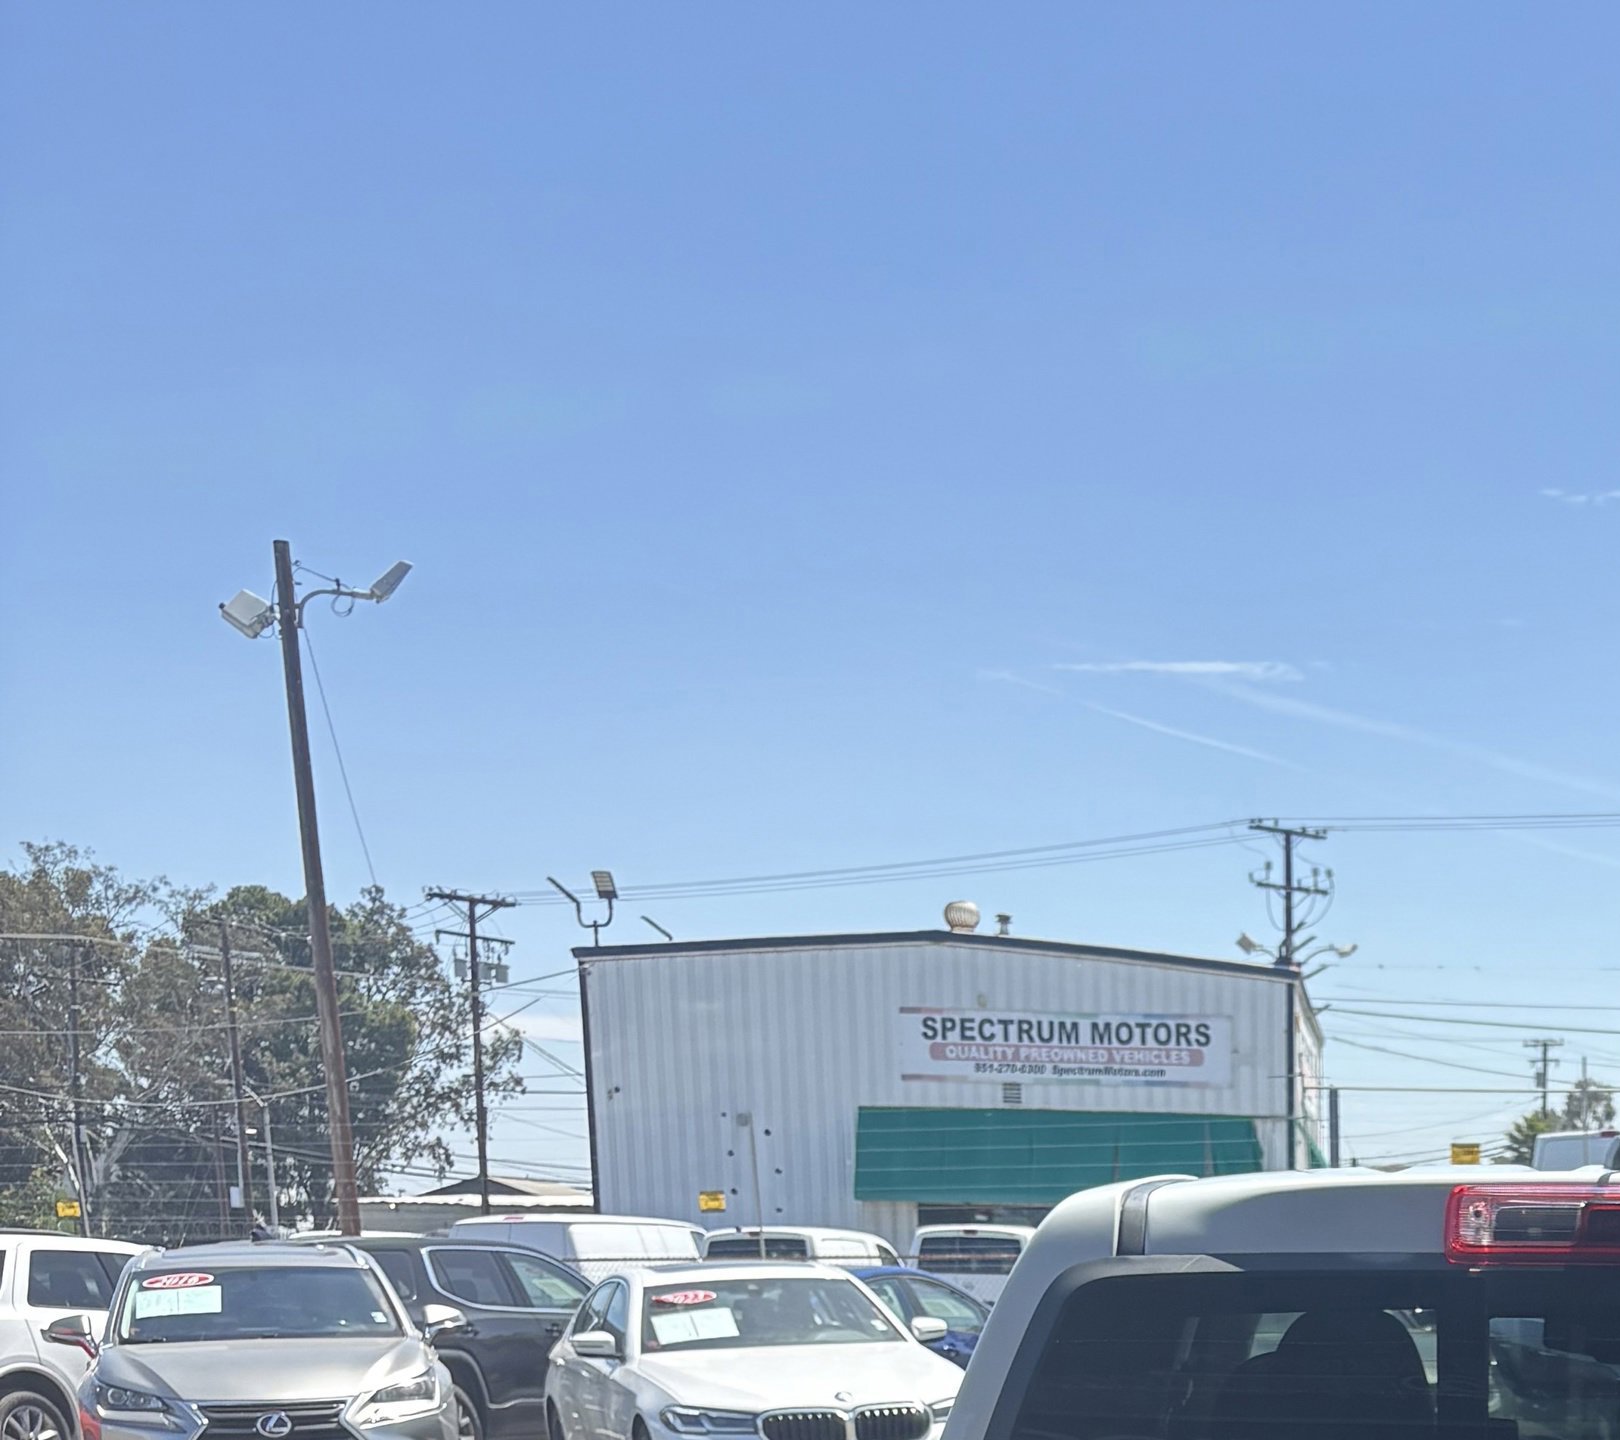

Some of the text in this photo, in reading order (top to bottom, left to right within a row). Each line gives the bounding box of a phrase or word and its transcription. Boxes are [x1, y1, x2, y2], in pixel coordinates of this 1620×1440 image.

[921, 1016, 1212, 1047] SPECTRUM MOTORS
[945, 1046, 1191, 1066] QUALITY PREOWNED VEHICLES
